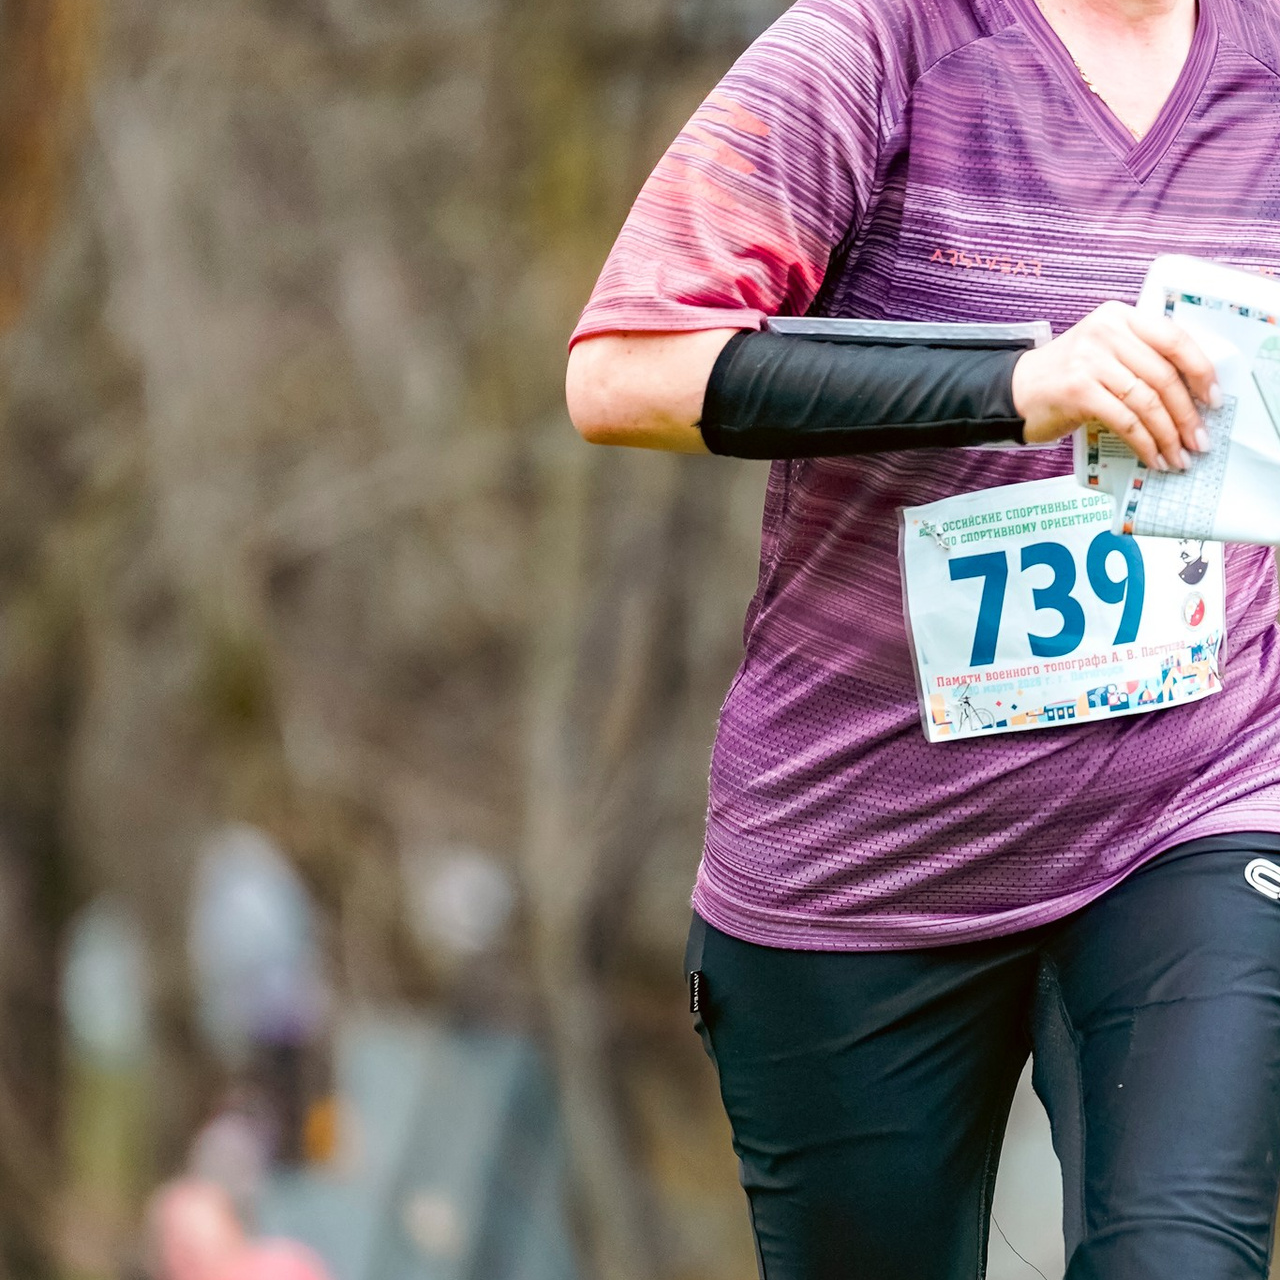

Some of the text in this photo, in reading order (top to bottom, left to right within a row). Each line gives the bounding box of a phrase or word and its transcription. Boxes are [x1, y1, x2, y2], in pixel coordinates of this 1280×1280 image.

[918, 494, 1111, 537] ВСЕОССИЙСКИЕ СПОРТИВНЫЕ СОРЕ
[960, 522, 1037, 544] СПОРТИВНОМУ
[948, 529, 1146, 667] 739
[936, 672, 981, 688] Памяти
[985, 665, 1040, 682] военного
[1043, 653, 1108, 673] топографа
